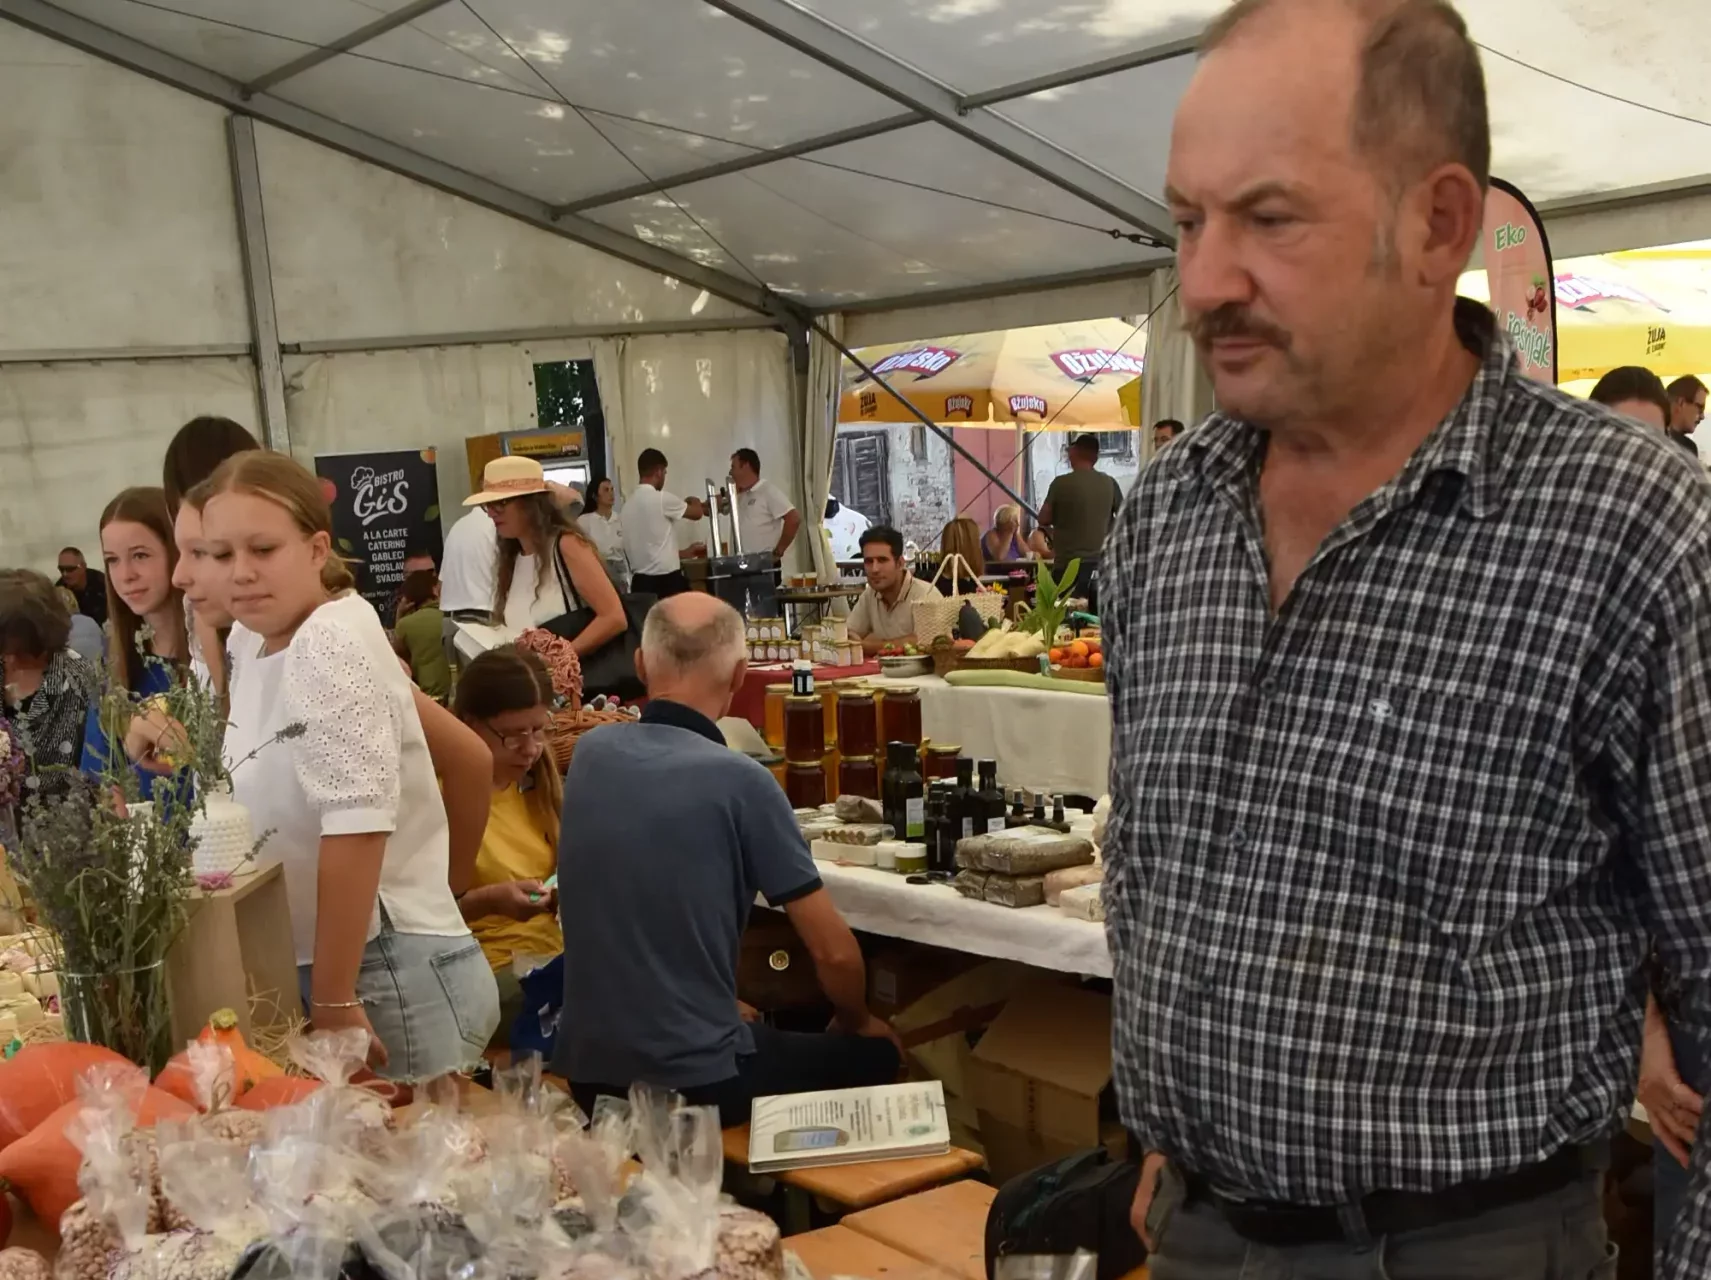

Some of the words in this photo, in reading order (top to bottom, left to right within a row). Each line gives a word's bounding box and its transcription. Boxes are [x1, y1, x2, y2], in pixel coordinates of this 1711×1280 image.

[1494, 222, 1526, 250] Eko
[1497, 308, 1551, 369] ješnjak
[1010, 395, 1045, 412] Ožujsko
[374, 468, 405, 487] BISTRO
[363, 531, 369, 540] A
[370, 530, 381, 540] LA
[382, 528, 408, 539] CARTE
[368, 540, 406, 551] CATERING
[372, 551, 405, 562] GABLECI
[369, 562, 405, 573] PROSLAV
